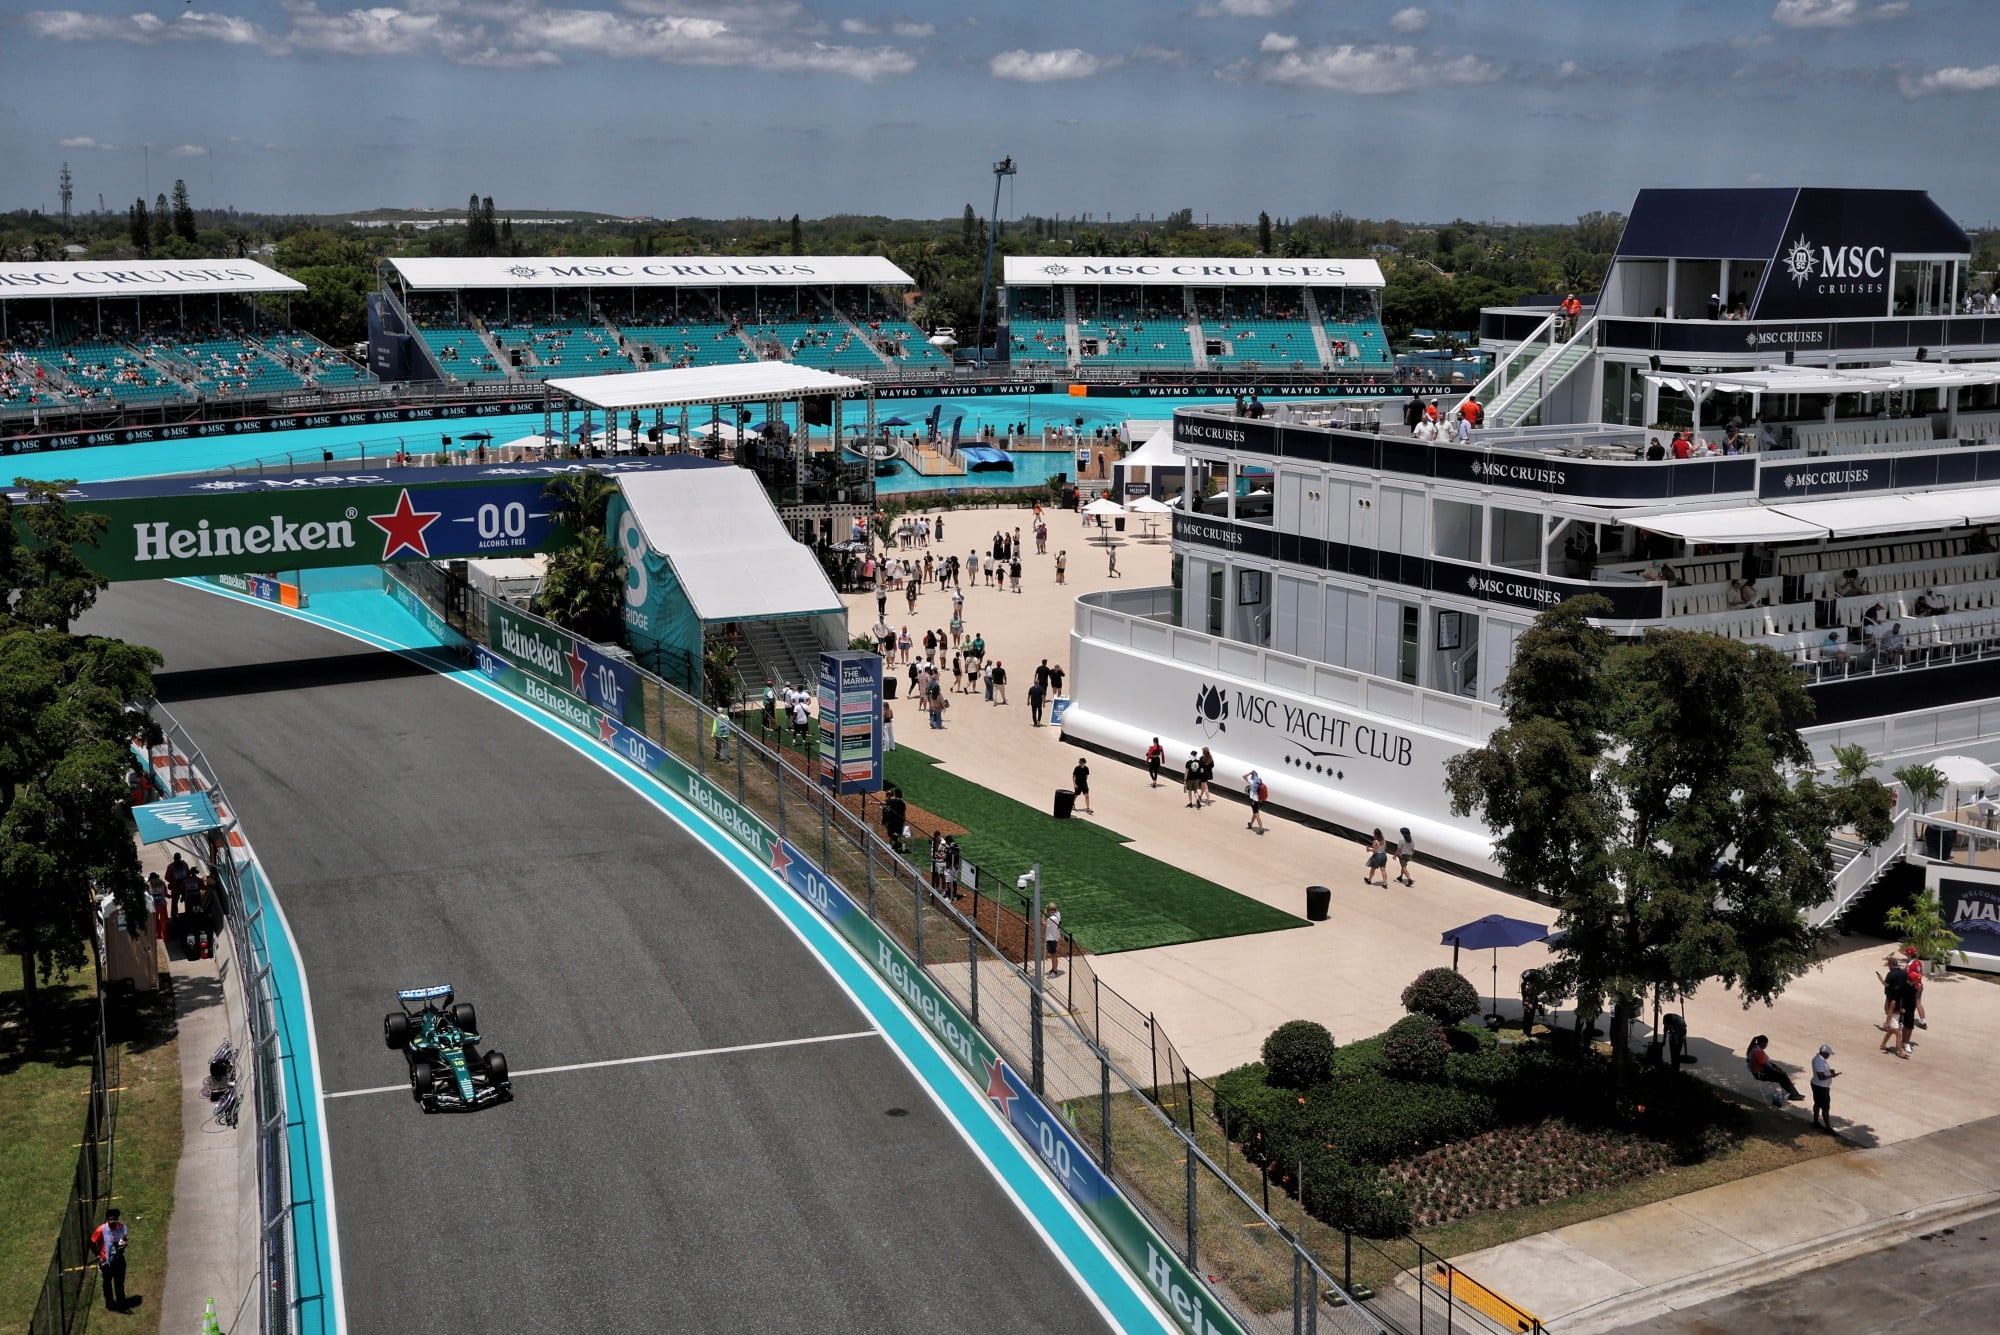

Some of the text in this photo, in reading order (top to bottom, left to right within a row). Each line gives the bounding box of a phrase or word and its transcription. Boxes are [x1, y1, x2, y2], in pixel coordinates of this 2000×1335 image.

[1820, 246, 1885, 278] MSC
[550, 264, 815, 277] MSC CRUISES
[1082, 265, 1346, 277] MSC CRUISES
[72, 268, 254, 285] CRUISES
[1818, 284, 1882, 294] CRUISES
[1758, 331, 1823, 344] MSC CRUISES
[880, 388, 917, 397] WAYMO
[941, 387, 977, 396] WAYMO
[1000, 385, 1036, 393] WAYMO
[1149, 386, 1189, 395] WAYMO
[1215, 386, 1255, 395] WAYMO
[1281, 386, 1320, 395] WAYMO
[1346, 386, 1386, 395] WAYMO
[1411, 386, 1451, 394] WAYMO
[450, 407, 467, 416] MSC
[484, 405, 501, 414] MSC
[517, 403, 534, 412] MSC
[348, 414, 366, 422] MSC
[382, 411, 400, 420] MSC
[416, 409, 434, 418] MSC
[243, 421, 261, 430] MSC
[279, 418, 297, 428] MSC
[314, 416, 331, 425] MSC
[171, 426, 189, 436] MSC
[208, 424, 226, 433] MSC
[1185, 424, 1245, 442] MSC CRUISES
[96, 433, 116, 442] MSC
[135, 430, 153, 439] MSC
[21, 440, 40, 449] MSC
[60, 436, 78, 446] MSC
[1482, 462, 1565, 485] MSC CRUISES
[1795, 469, 1869, 486] MSC CRUISES
[478, 502, 525, 538] 0.0
[1183, 524, 1243, 544] MSC CRUISES
[478, 538, 526, 548] ALCOHOL FREE
[618, 510, 648, 607] 8
[1479, 578, 1561, 605] MSC CRUISES
[599, 664, 617, 705] 0.0
[843, 676, 874, 685] MARINA
[1236, 692, 1412, 766] MSC YACHT CLUB
[629, 737, 646, 763] 0.0
[807, 873, 828, 909] 0.0
[1953, 900, 2000, 923] MA
[1040, 1122, 1070, 1178] 0.0
